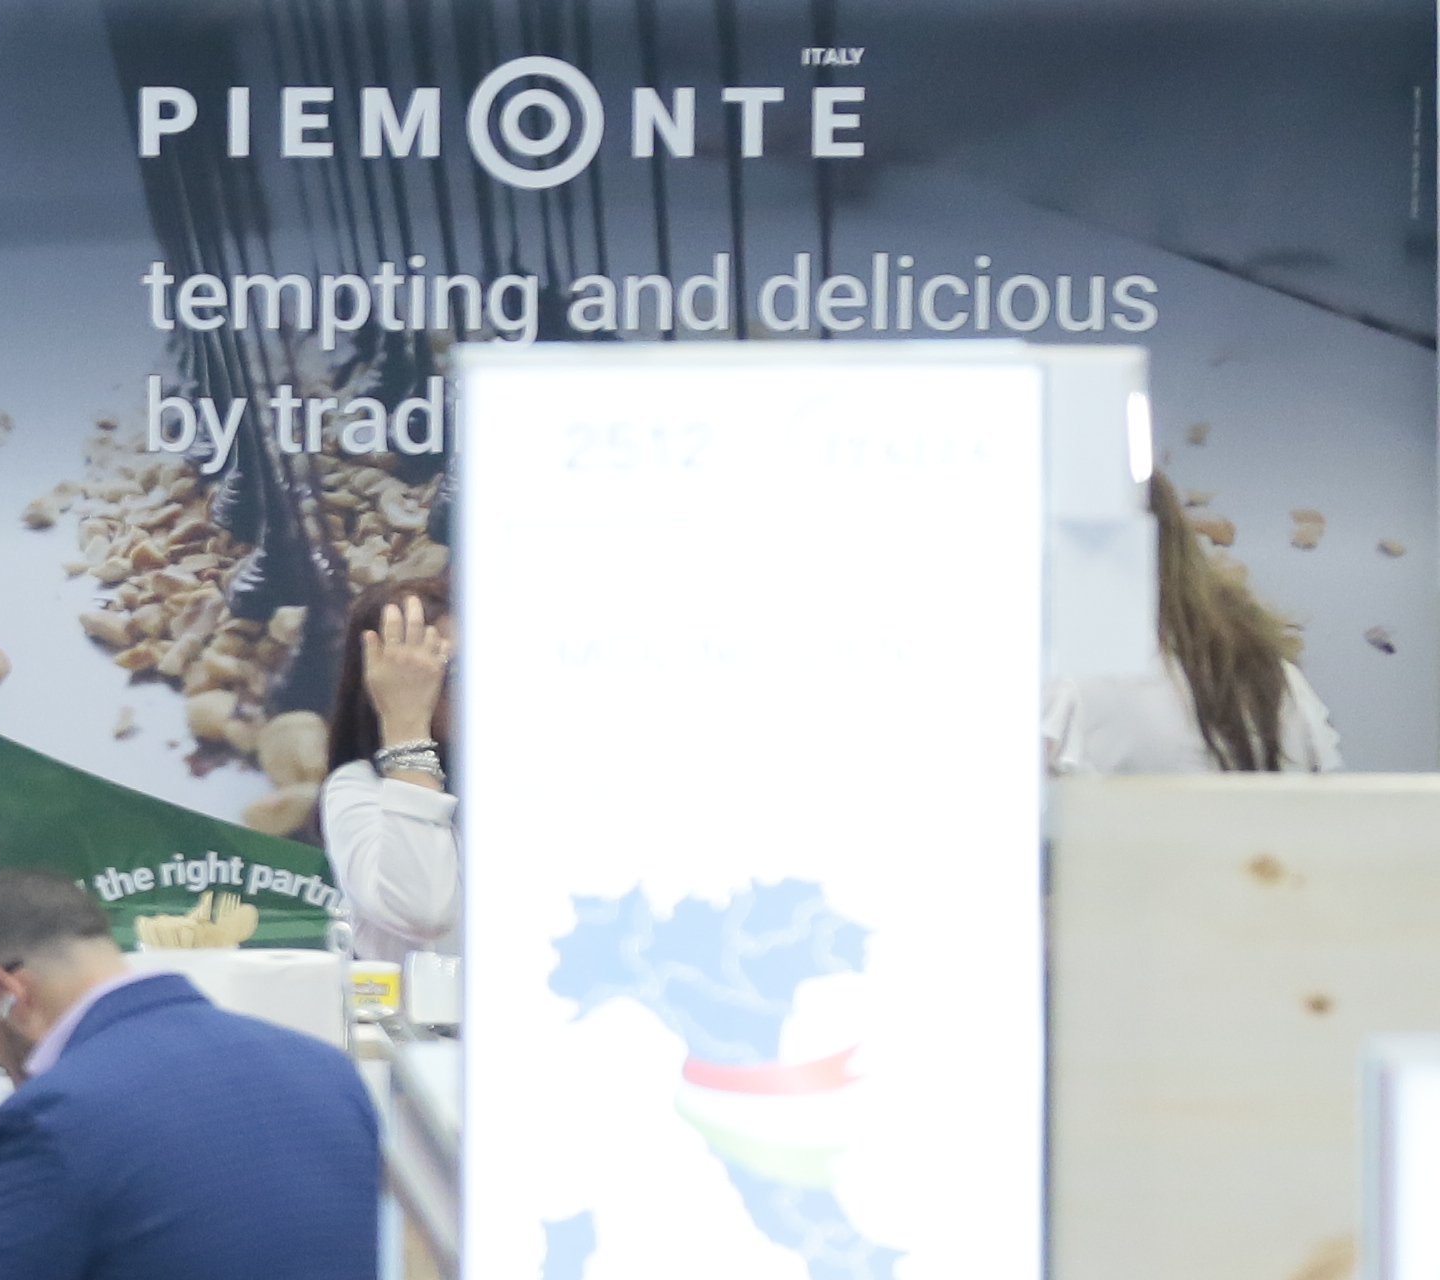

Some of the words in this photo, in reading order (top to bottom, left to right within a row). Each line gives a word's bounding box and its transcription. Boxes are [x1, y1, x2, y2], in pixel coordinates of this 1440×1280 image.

[801, 47, 864, 67] ITALY
[138, 56, 866, 190] PIEMONTE
[140, 253, 541, 351] tempting
[568, 252, 733, 333] and
[757, 251, 1158, 333] delicious
[146, 373, 248, 474] by
[562, 420, 716, 472] 2512
[95, 867, 155, 902] the
[159, 851, 244, 892] right
